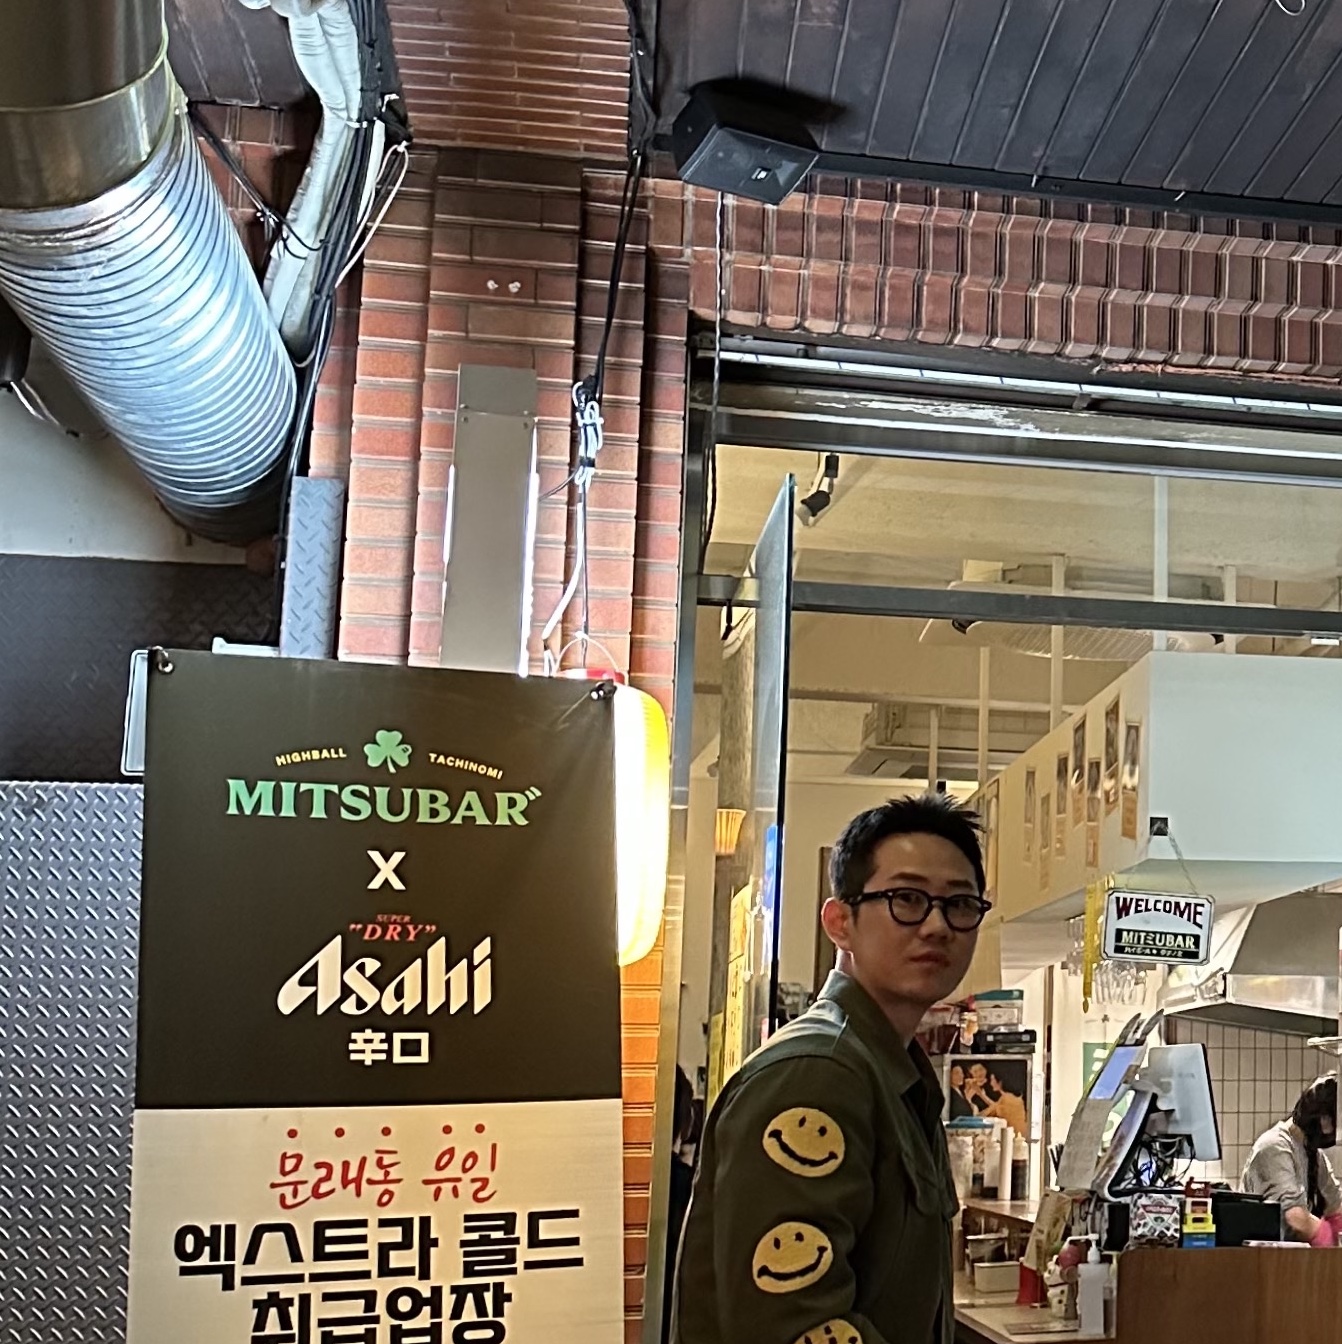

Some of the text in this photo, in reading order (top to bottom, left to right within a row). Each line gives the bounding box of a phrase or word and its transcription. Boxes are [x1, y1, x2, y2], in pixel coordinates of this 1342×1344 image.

[275, 747, 503, 780] HIGHBALL TACHINOMI
[376, 914, 411, 923] SUPER
[1115, 896, 1205, 930] WELCOME
[276, 934, 491, 1016] Asahi
[348, 1028, 430, 1065] 辛口
[269, 1142, 499, 1210] 문래동 유일
[173, 1209, 584, 1291] 엑스트라 콜드
